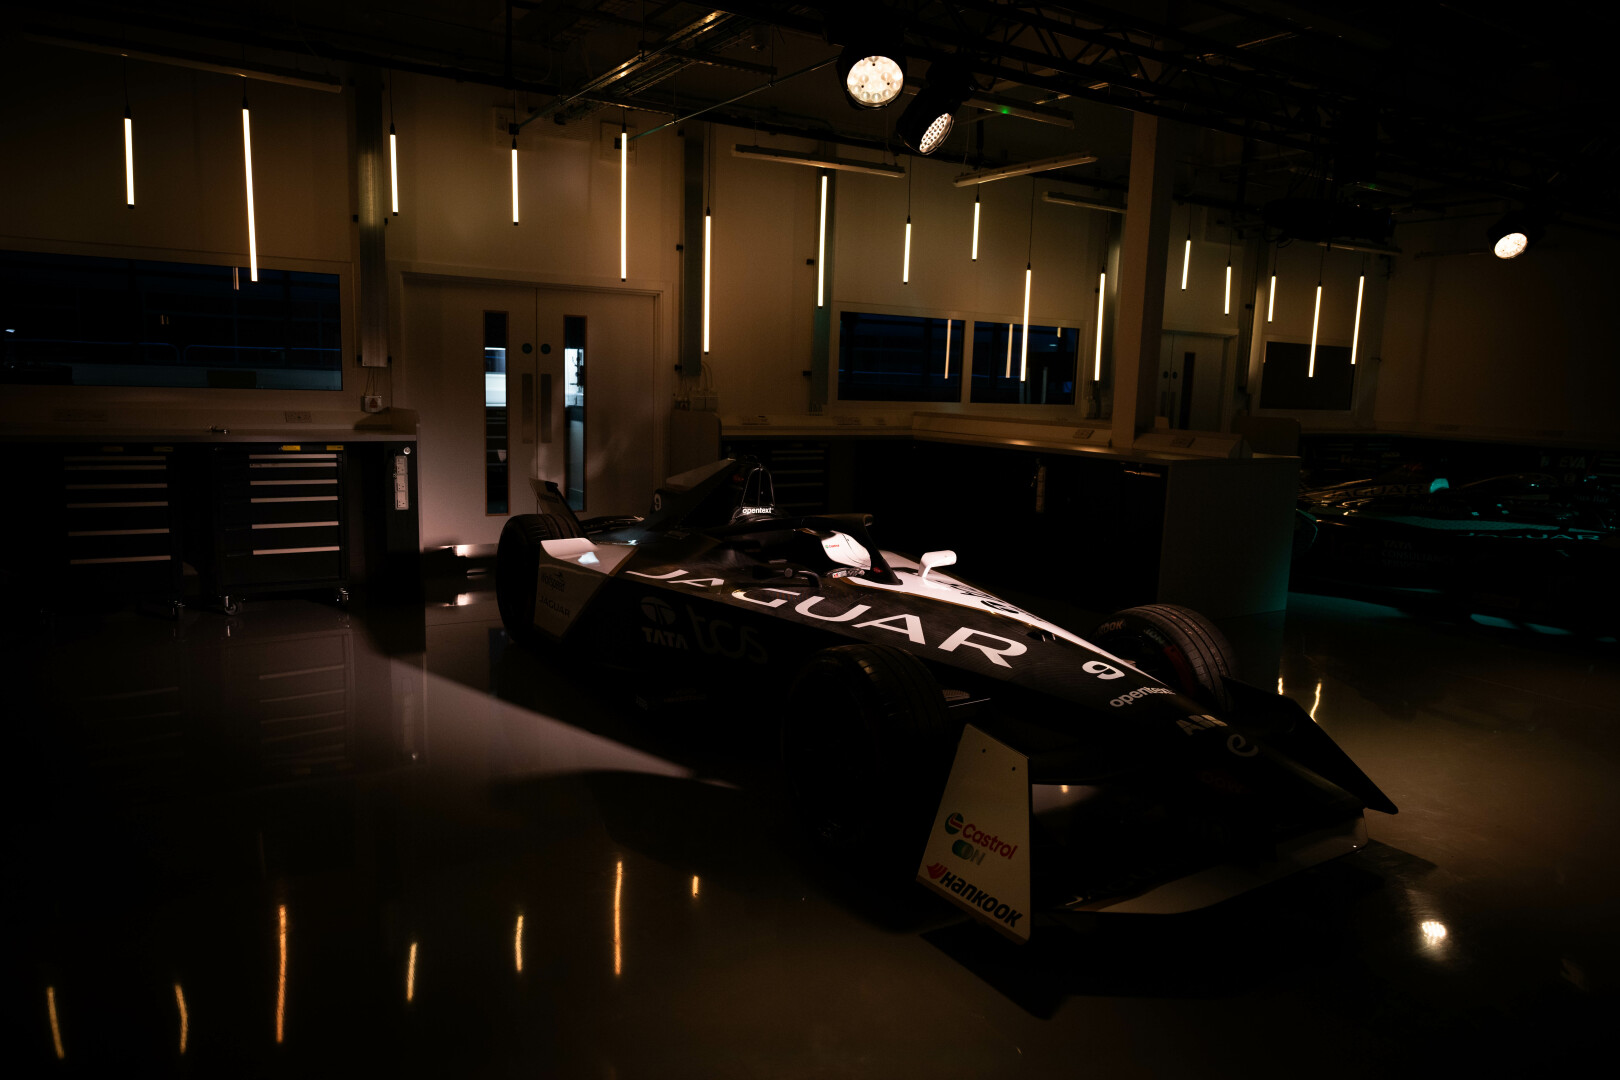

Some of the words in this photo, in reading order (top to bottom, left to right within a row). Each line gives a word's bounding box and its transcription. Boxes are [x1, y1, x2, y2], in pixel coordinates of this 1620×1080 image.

[742, 505, 774, 516] opentext
[540, 595, 571, 618] JAGUAR
[625, 569, 1028, 669] JAGUAR
[640, 626, 689, 651] TATA
[1082, 660, 1126, 680] 9
[962, 822, 1018, 860] Castrol
